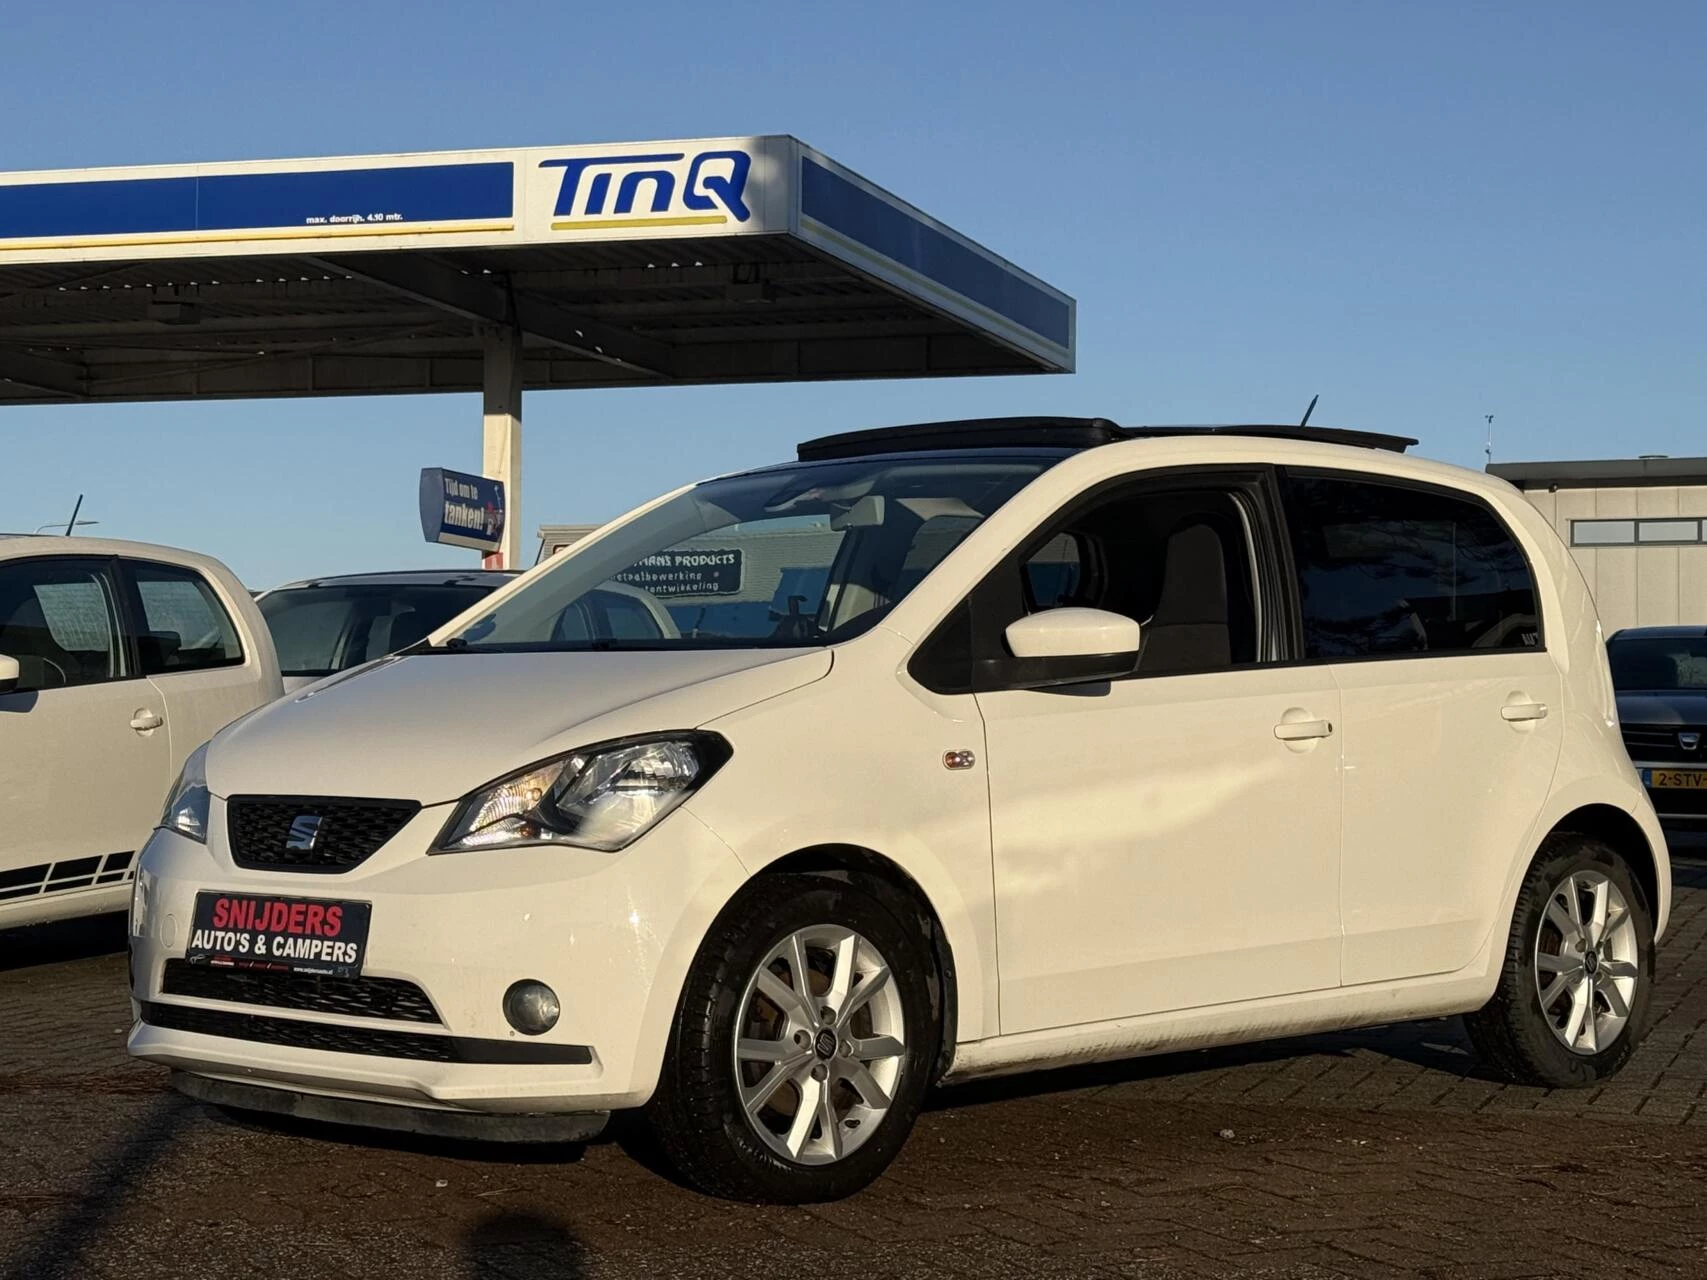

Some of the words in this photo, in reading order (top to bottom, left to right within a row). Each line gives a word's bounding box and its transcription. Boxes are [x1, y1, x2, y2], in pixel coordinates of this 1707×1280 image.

[306, 216, 328, 224] max.
[444, 501, 485, 530] tanken!
[675, 553, 735, 567] PRODUCTS
[611, 571, 702, 582] etaalbewerking
[212, 897, 343, 937] SNIJDERS
[191, 929, 250, 954] AUTO'S
[254, 934, 267, 955] &
[272, 936, 358, 964] CAMPERS
